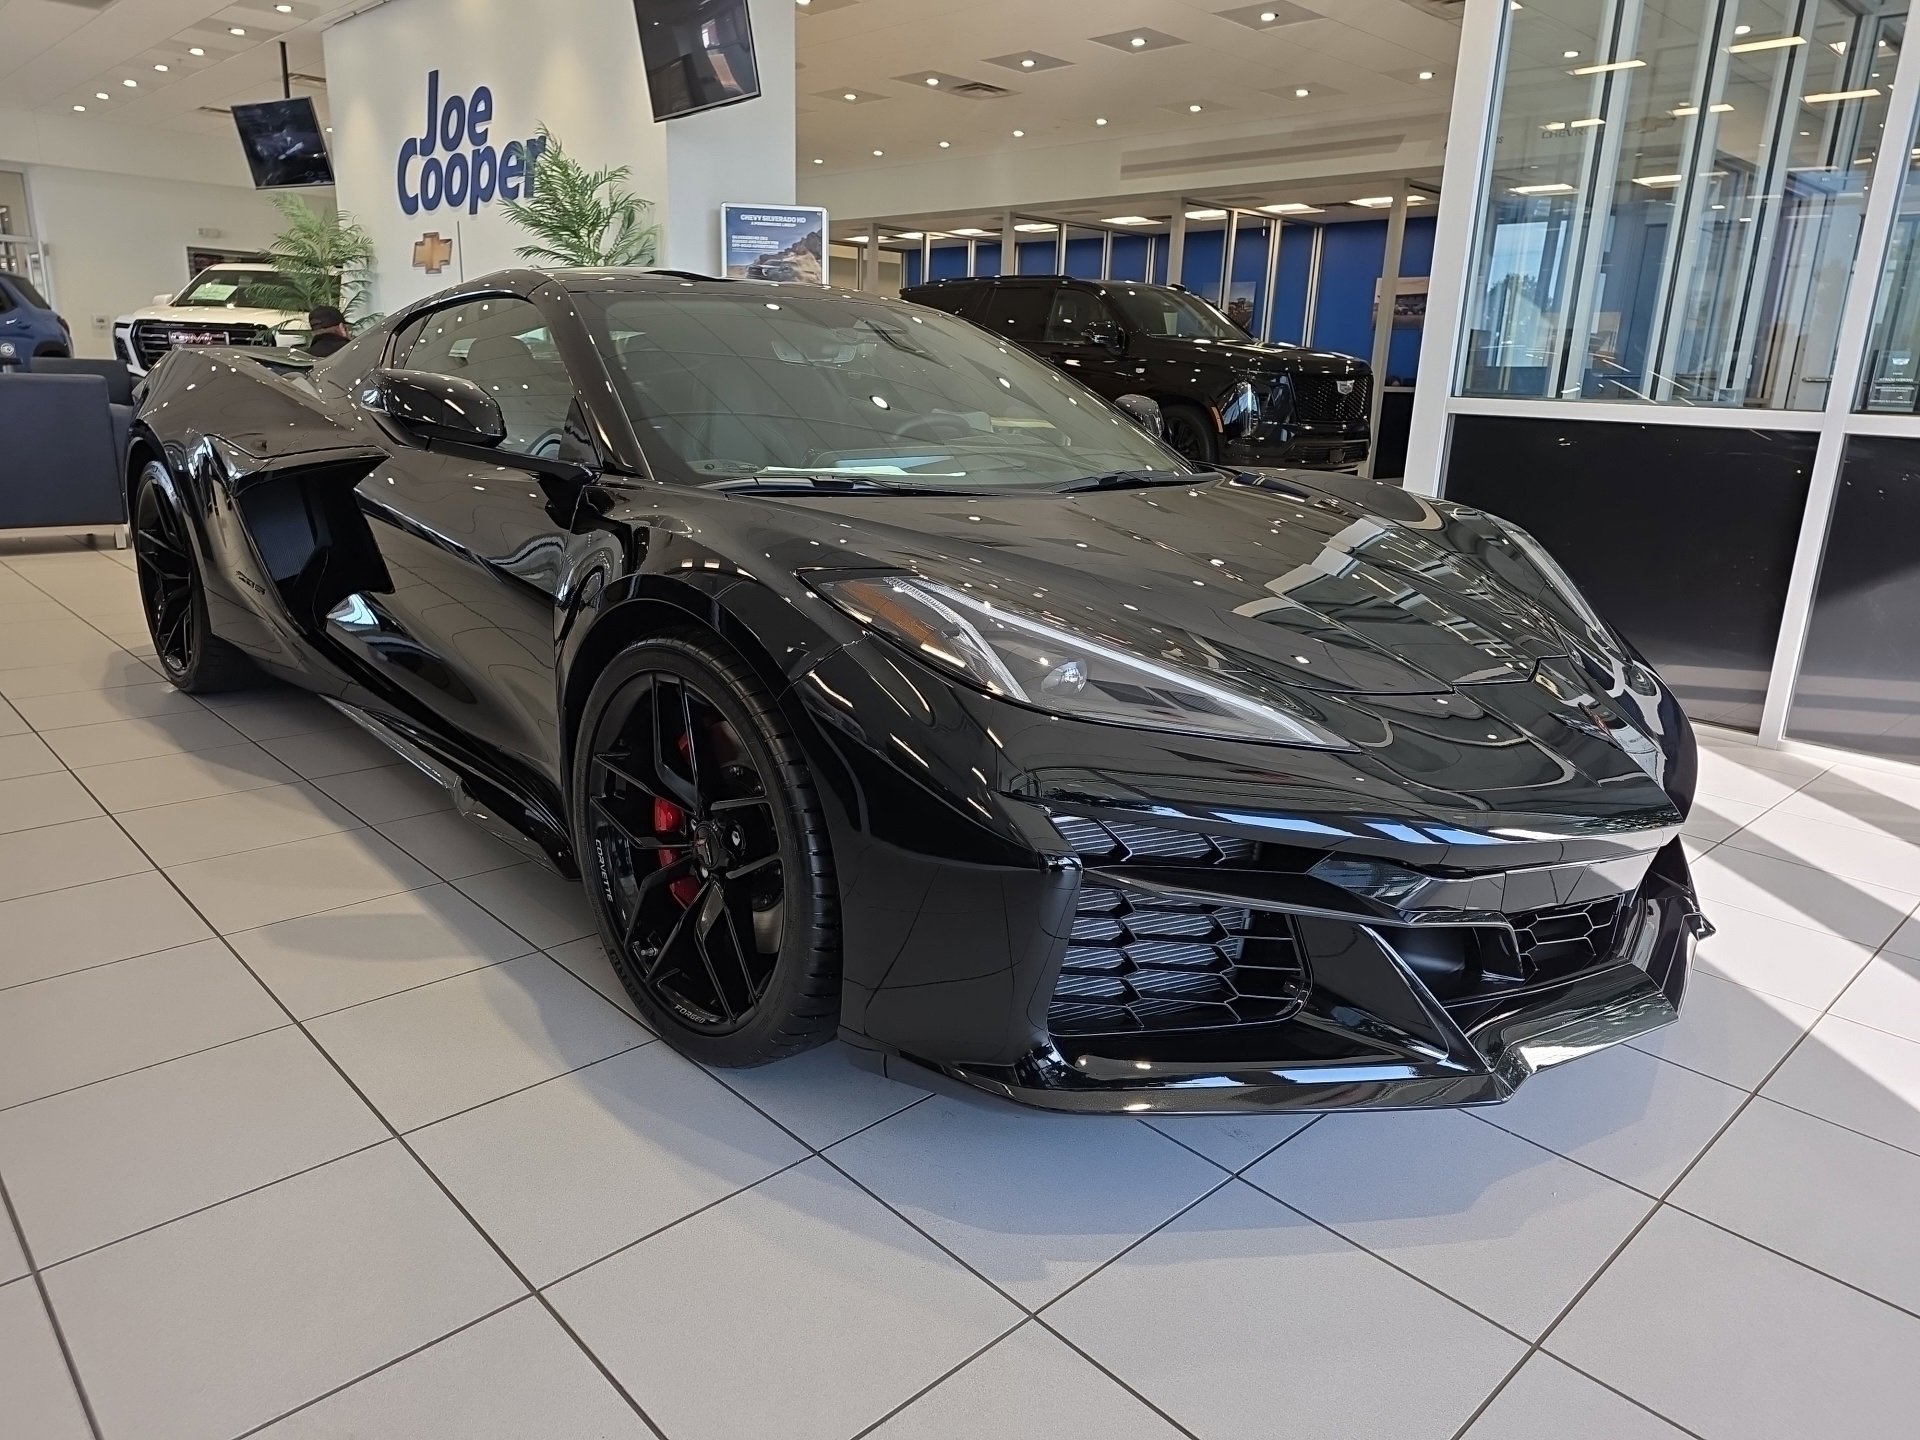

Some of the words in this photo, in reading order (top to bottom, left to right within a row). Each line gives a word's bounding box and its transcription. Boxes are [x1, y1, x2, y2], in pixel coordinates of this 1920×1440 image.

[419, 69, 493, 156] Joe
[398, 136, 547, 215] Cooper
[761, 215, 796, 223] SILVERADO
[595, 838, 614, 904] CORVETTE
[673, 1003, 706, 1025] FORGED
